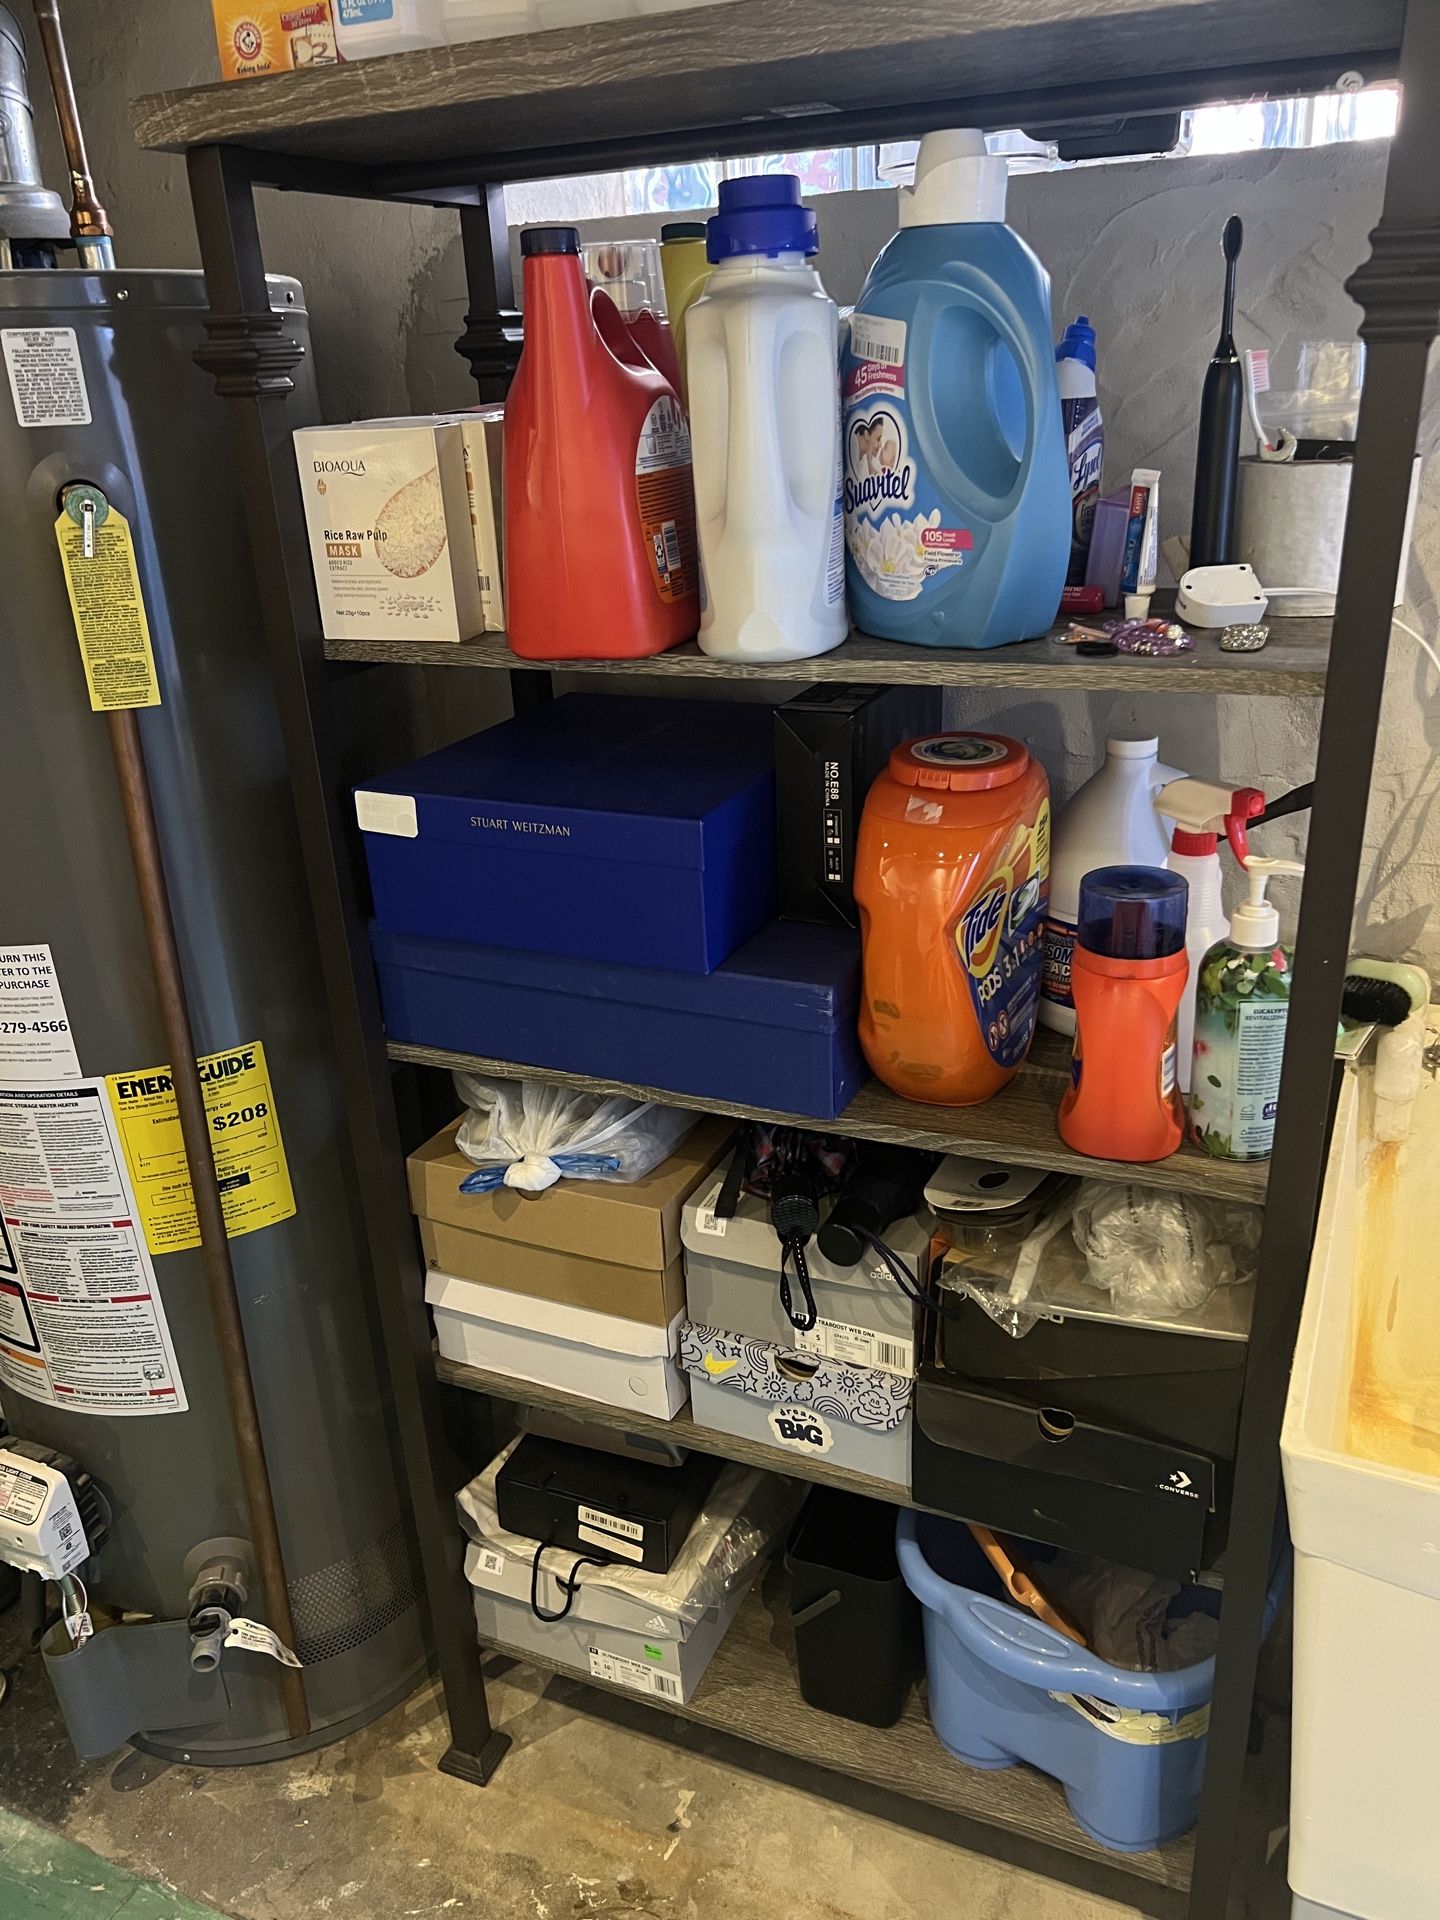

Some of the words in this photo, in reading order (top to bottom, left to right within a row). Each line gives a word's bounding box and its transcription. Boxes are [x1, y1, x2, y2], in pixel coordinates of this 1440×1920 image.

[855, 366, 867, 387] 45
[313, 459, 367, 476] BIOAQUA
[1073, 447, 1102, 491] Lysol
[844, 465, 910, 514] Suavitel
[324, 529, 344, 541] Rice
[346, 530, 365, 541] Raw
[366, 529, 388, 542] Pulp
[924, 531, 943, 543] 105
[329, 545, 359, 557] MASK
[830, 761, 840, 800] NO.E88
[470, 816, 508, 830] STUART
[512, 820, 570, 836] WEITZMAN
[961, 886, 1007, 969] Tide
[22, 953, 46, 962] THIS
[0, 967, 14, 976] ER
[16, 967, 30, 976] TO
[32, 966, 52, 975] THE
[0, 979, 50, 989] PURCHASE
[977, 966, 1002, 1008] PODS
[219, 1101, 232, 1109] Cost
[212, 1102, 268, 1132] $208
[817, 1319, 847, 1332] TRABOOST
[848, 1328, 861, 1336] WEB
[862, 1331, 875, 1339] DNA
[815, 1334, 821, 1342] 5
[780, 1408, 817, 1423] dream
[775, 1418, 823, 1446] BIG
[1159, 1483, 1199, 1499] CONVERSE
[645, 1621, 671, 1634] adidas
